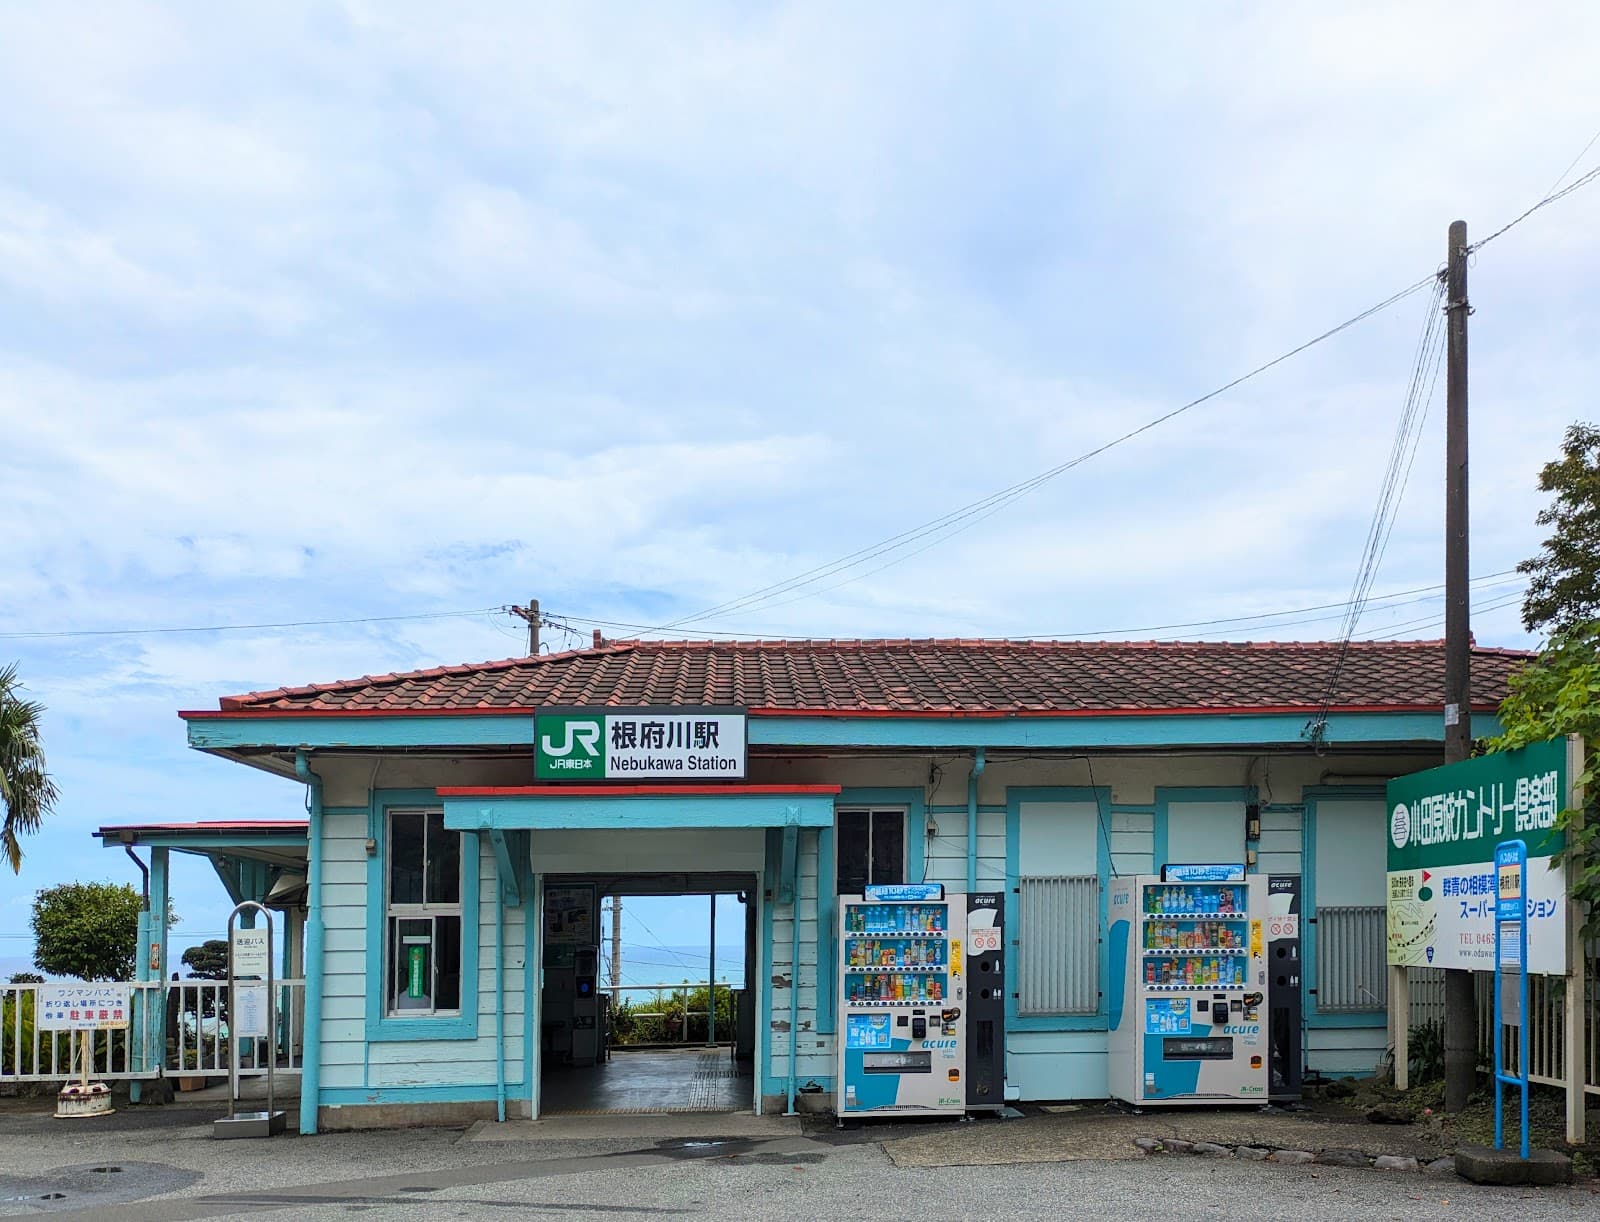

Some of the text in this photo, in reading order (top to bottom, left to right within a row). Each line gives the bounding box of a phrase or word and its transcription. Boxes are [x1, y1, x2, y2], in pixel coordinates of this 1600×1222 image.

[542, 721, 600, 756] JR
[611, 721, 720, 750] 根府川駅
[549, 759, 593, 770] JR東日本
[610, 755, 737, 771] Nebukawa Station
[1410, 771, 1557, 847] 小田原城カントリー倶楽部
[1500, 874, 1520, 890] 根府川駅
[236, 937, 265, 946] 送迎バス
[1460, 933, 1496, 945] TEL 0465
[58, 988, 111, 997] ワンマンバス
[45, 999, 123, 1009] 折り返し場所につき
[1223, 1025, 1260, 1034] acure
[921, 1039, 957, 1049] acure
